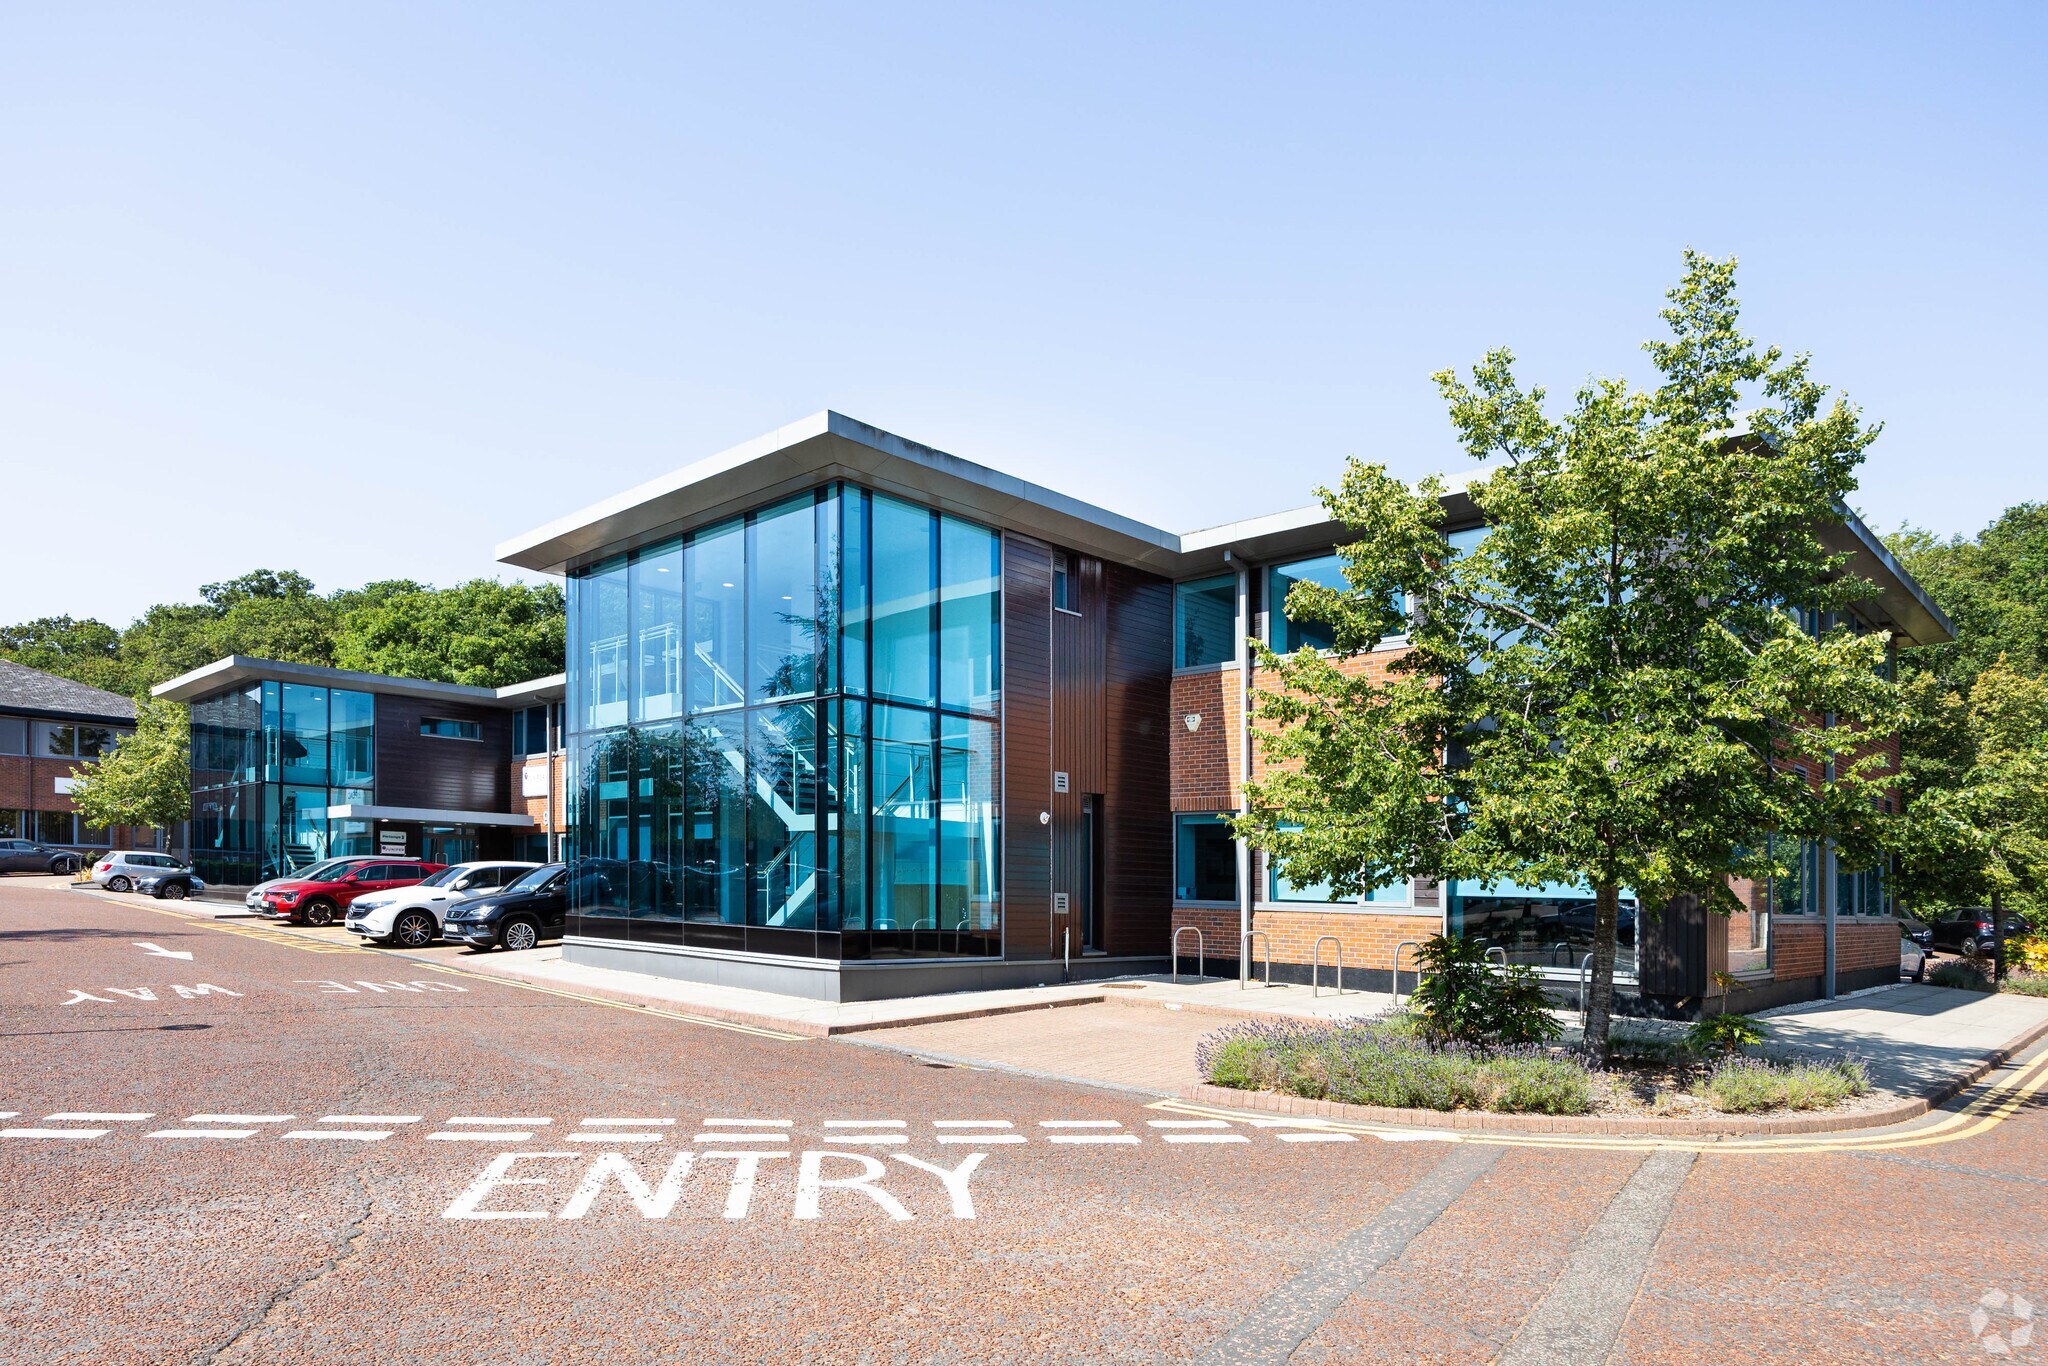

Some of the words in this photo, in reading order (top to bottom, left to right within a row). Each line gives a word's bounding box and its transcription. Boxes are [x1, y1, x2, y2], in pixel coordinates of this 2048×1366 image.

[60, 983, 245, 1006] WAY
[292, 980, 470, 993] ONE
[441, 1151, 989, 1221] ENTRY
